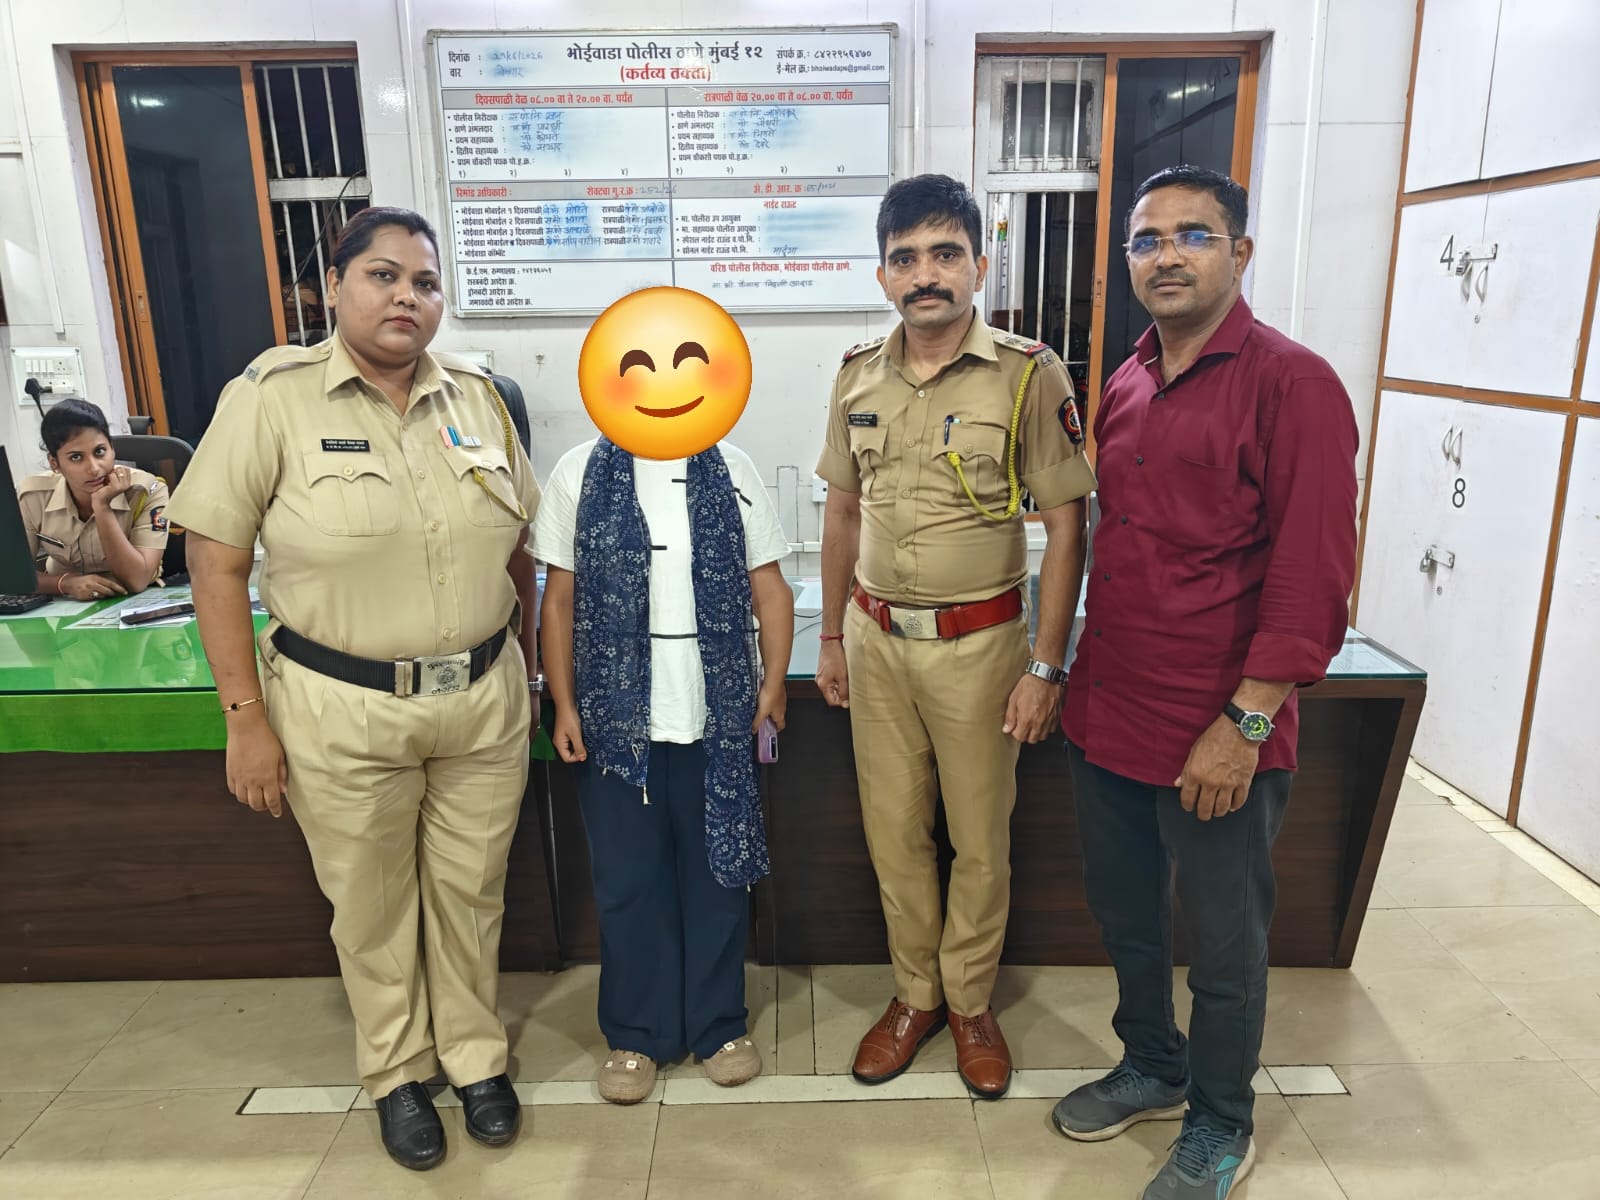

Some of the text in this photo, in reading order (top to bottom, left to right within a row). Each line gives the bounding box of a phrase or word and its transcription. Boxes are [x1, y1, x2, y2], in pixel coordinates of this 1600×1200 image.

[448, 49, 471, 62] दिनांक
[567, 42, 622, 62] भोईवाडा
[626, 42, 672, 59] पोलीस
[708, 41, 739, 63] मुंबई
[745, 46, 762, 58] १२
[776, 46, 794, 59] संपर्क
[450, 67, 462, 77] वार
[620, 62, 666, 82] (कर्तव्य
[475, 93, 513, 105] दिवसपाळी
[704, 90, 734, 102] रात्रपाळी
[736, 92, 748, 102] वेळ
[1440, 234, 1454, 271] 4
[728, 262, 750, 272] पोलीस
[811, 261, 834, 271] पोलीस
[1452, 478, 1466, 508] 8
